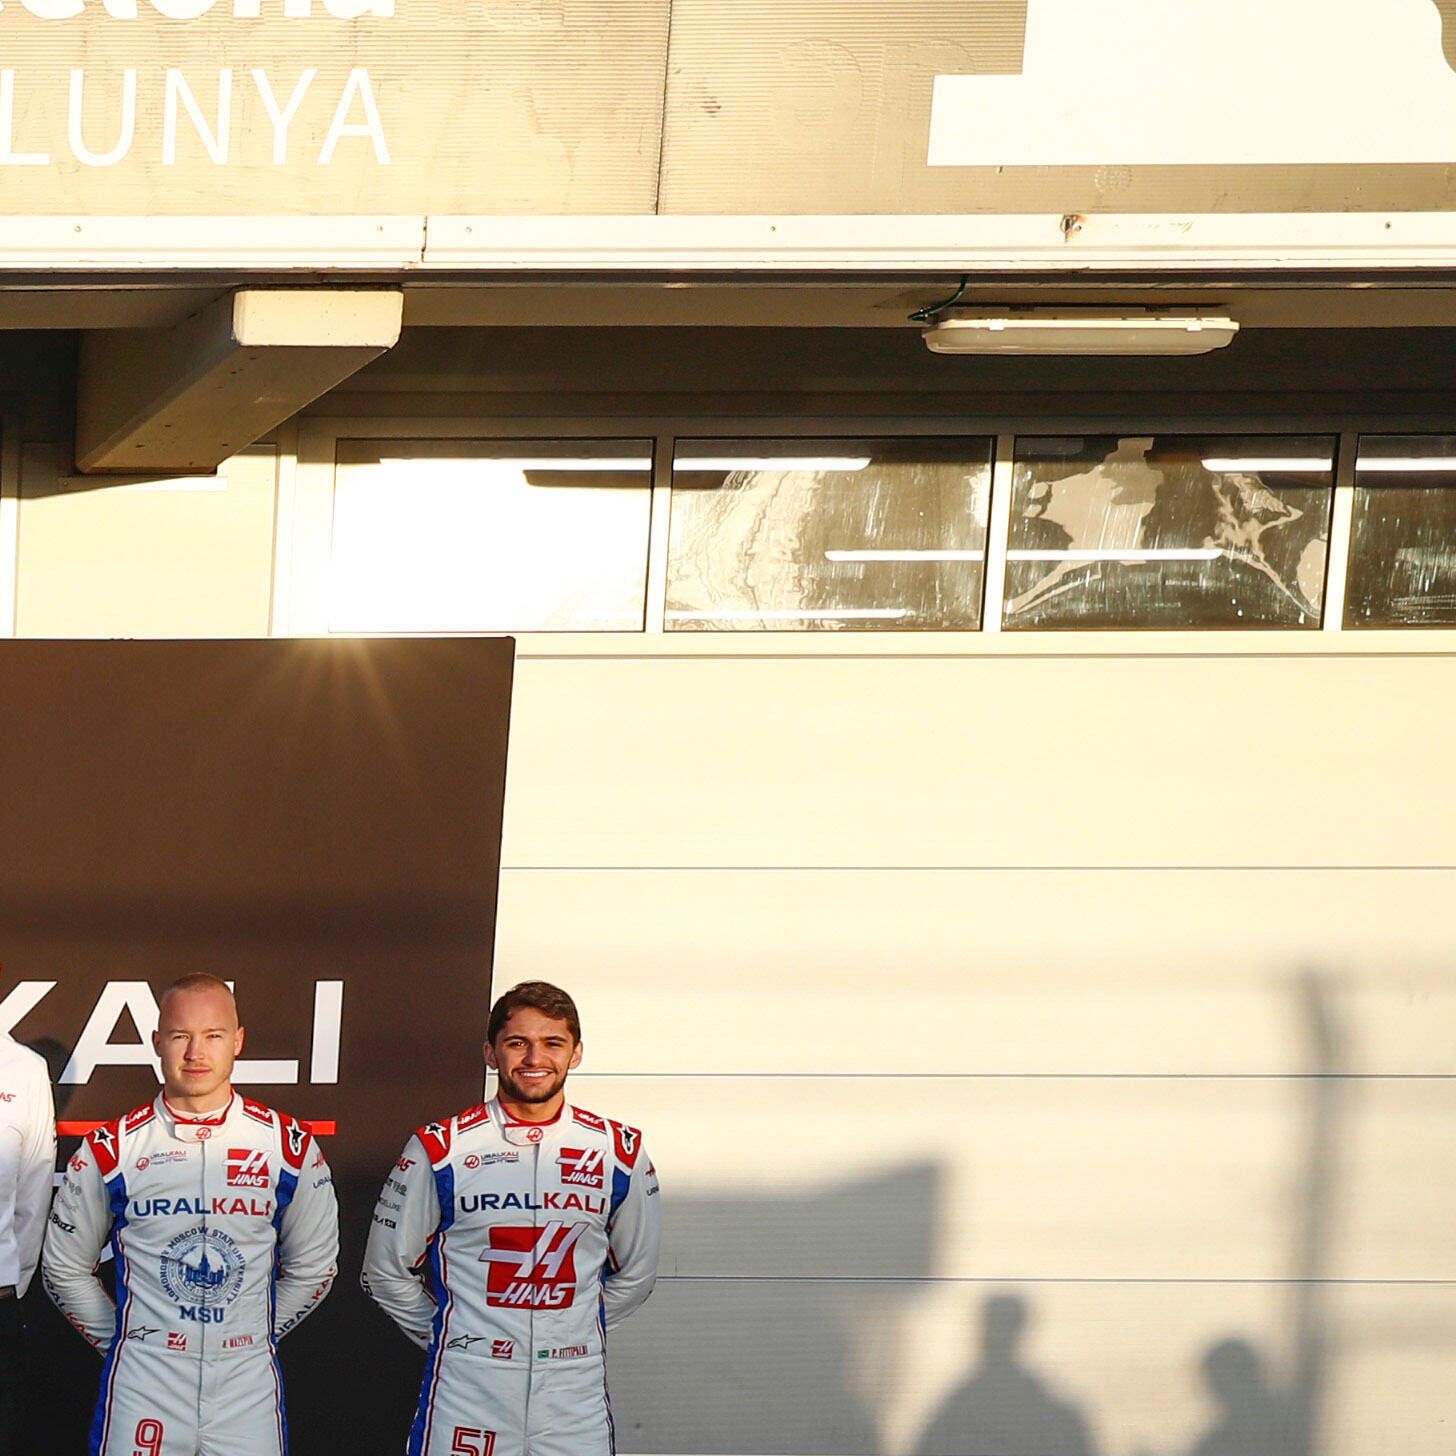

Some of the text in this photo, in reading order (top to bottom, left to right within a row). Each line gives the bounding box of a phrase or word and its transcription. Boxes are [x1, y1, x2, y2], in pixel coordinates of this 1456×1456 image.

[227, 1174, 270, 1187] HAAS
[564, 1174, 603, 1186] HAAS
[134, 1198, 271, 1217] URALKALI
[460, 1192, 606, 1214] URALKALI
[168, 1225, 208, 1249] MOSCOW
[487, 1281, 577, 1306] HAAS
[180, 1305, 225, 1323] MSU
